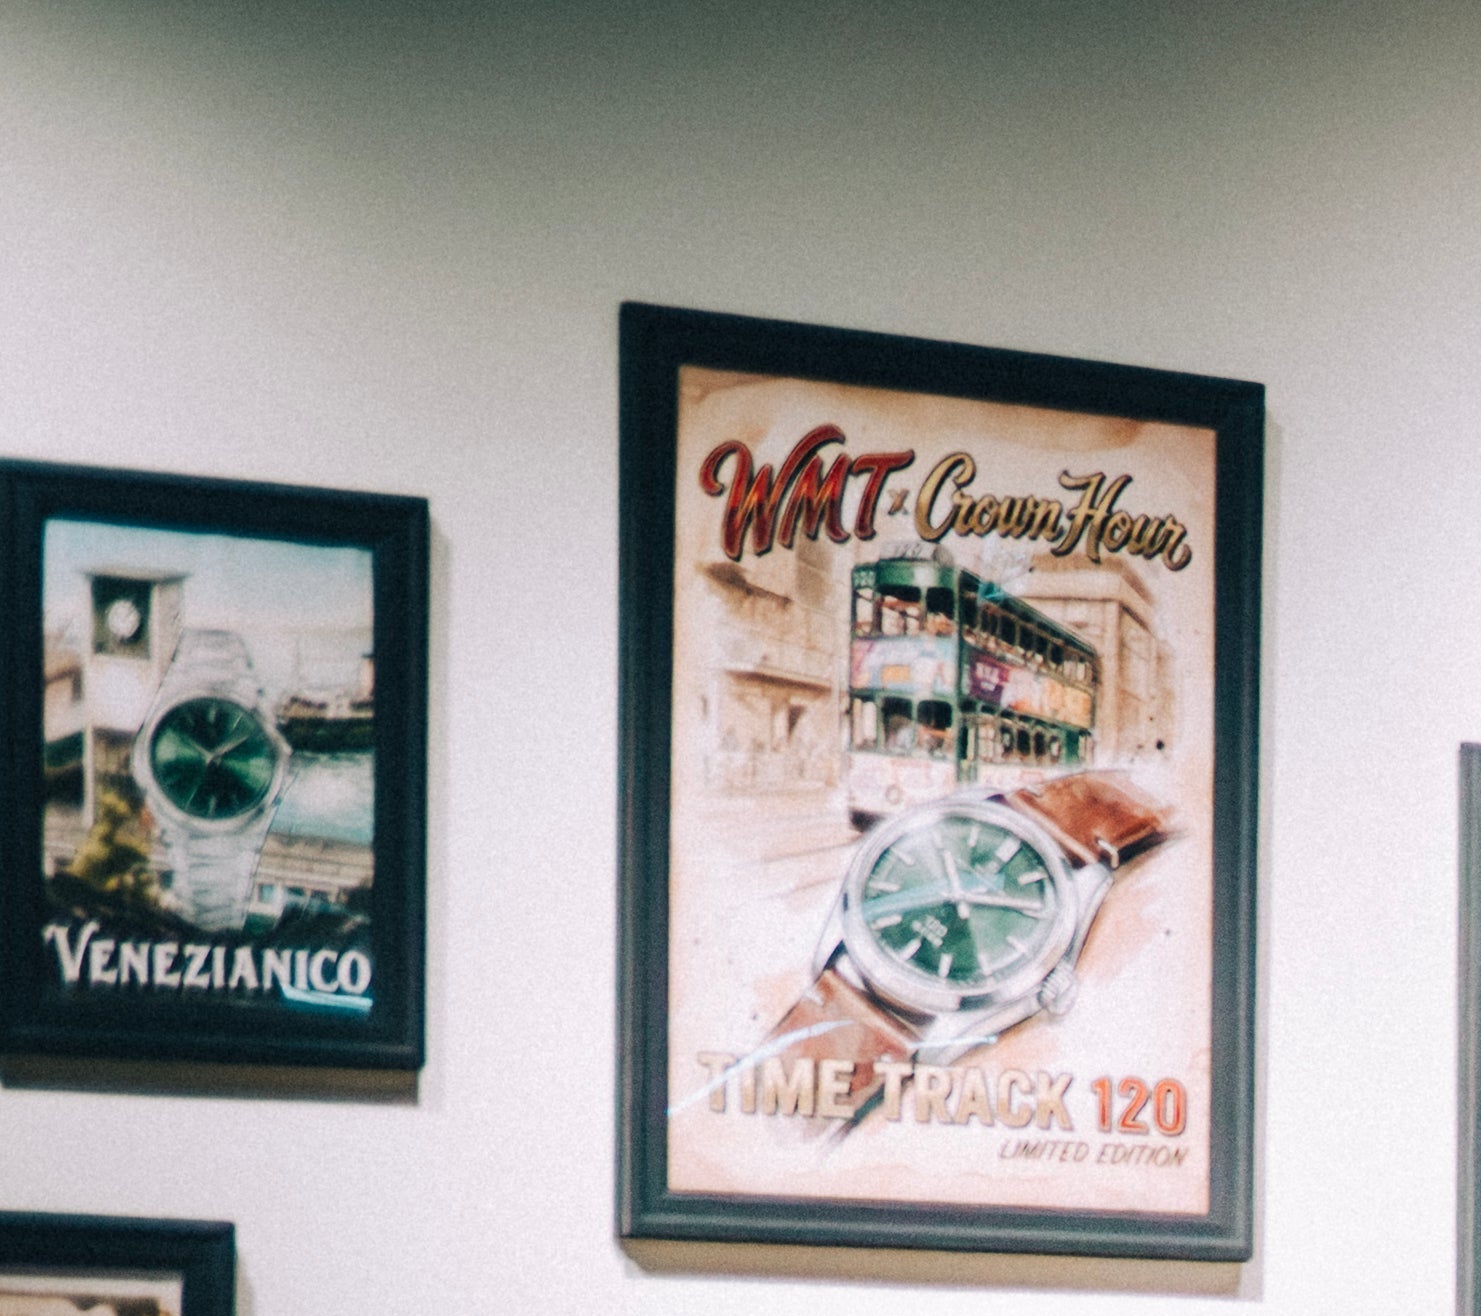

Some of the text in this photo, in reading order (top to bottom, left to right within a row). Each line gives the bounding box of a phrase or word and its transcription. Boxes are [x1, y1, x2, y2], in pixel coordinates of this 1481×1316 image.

[699, 422, 914, 561] WMT
[914, 451, 1064, 542] Crown
[1051, 469, 1192, 571] Hour
[42, 920, 373, 996] VENEZIANICO
[699, 1051, 1188, 1136] TIME TRACK 120
[1000, 1138, 1188, 1168] LIMITED EDITION
